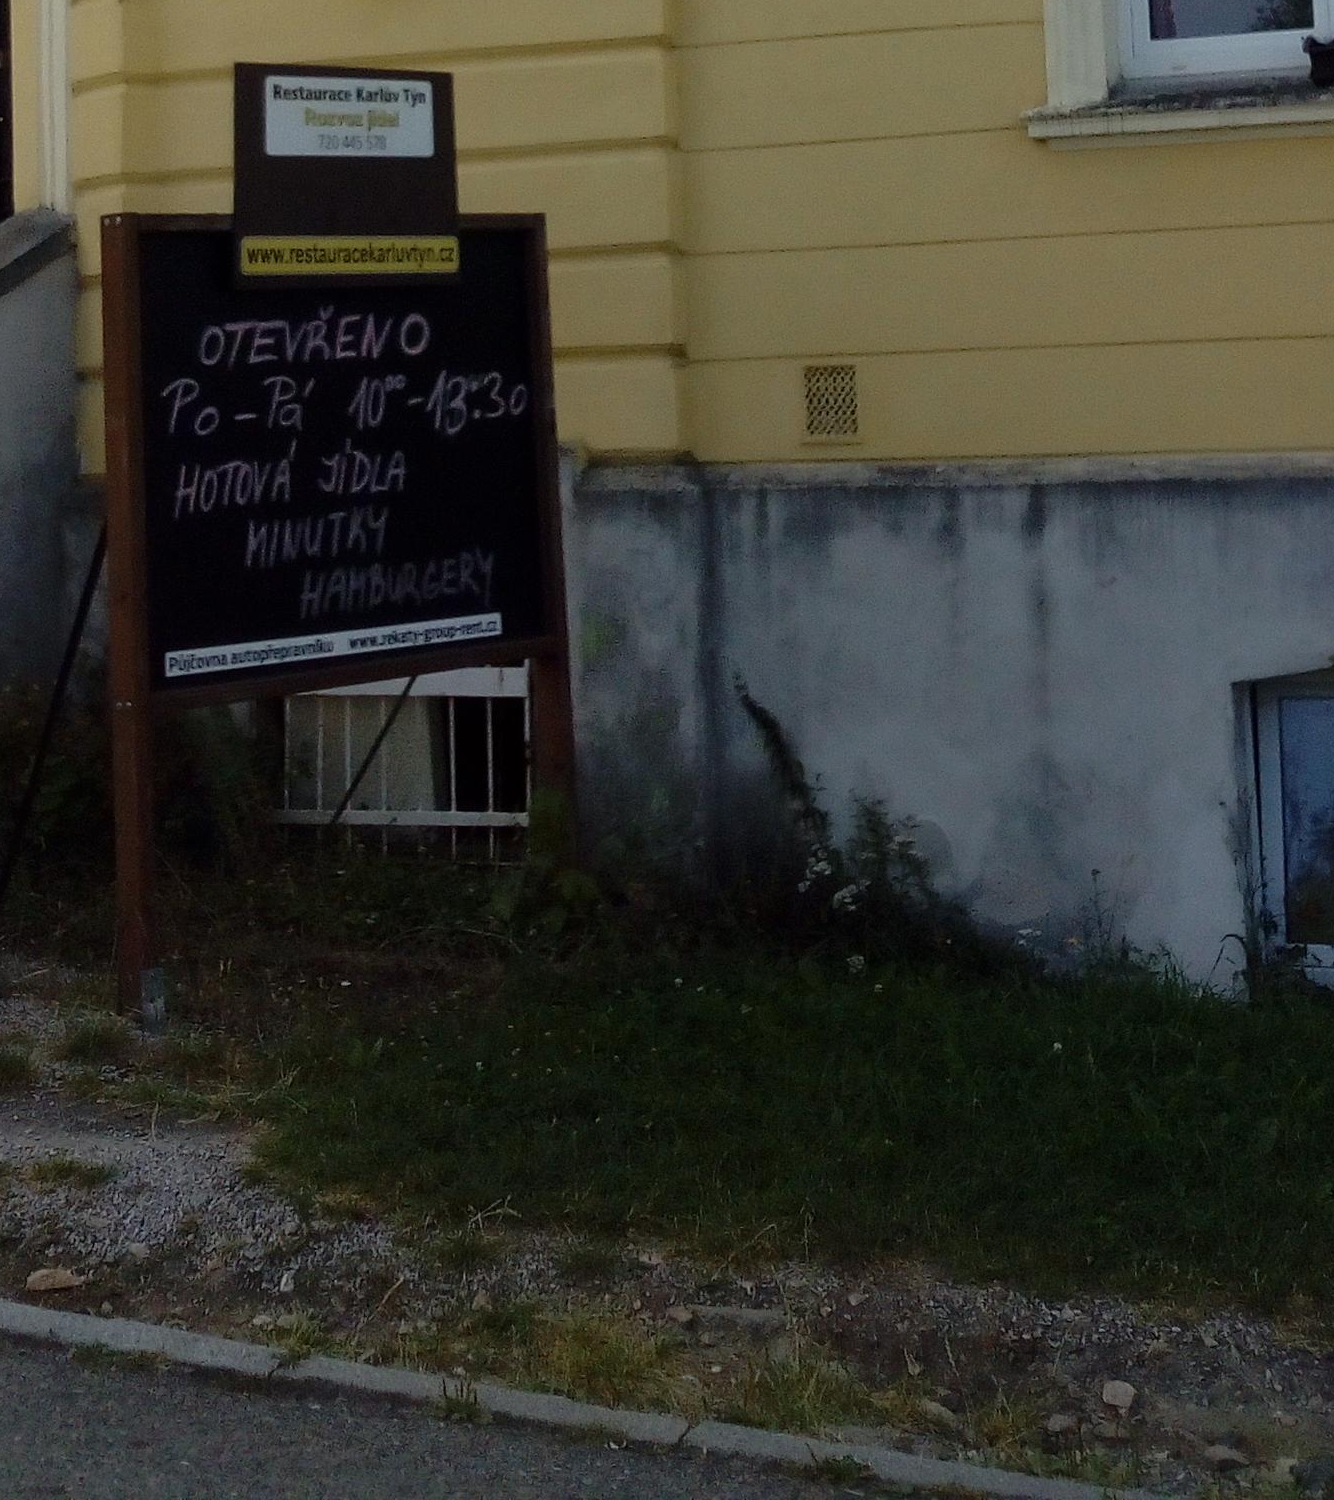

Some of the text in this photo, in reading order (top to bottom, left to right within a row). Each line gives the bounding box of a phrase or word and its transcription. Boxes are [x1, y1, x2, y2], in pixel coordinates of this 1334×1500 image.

[272, 83, 351, 102] Restaurace
[247, 242, 455, 268] www.restauracekarluvtyn.cz
[199, 305, 431, 370] OTEVŘENO
[174, 438, 407, 519] HOTOVÁ JÍDLA
[245, 506, 389, 568] MINUTKY
[300, 549, 495, 619] HAMBURGERY
